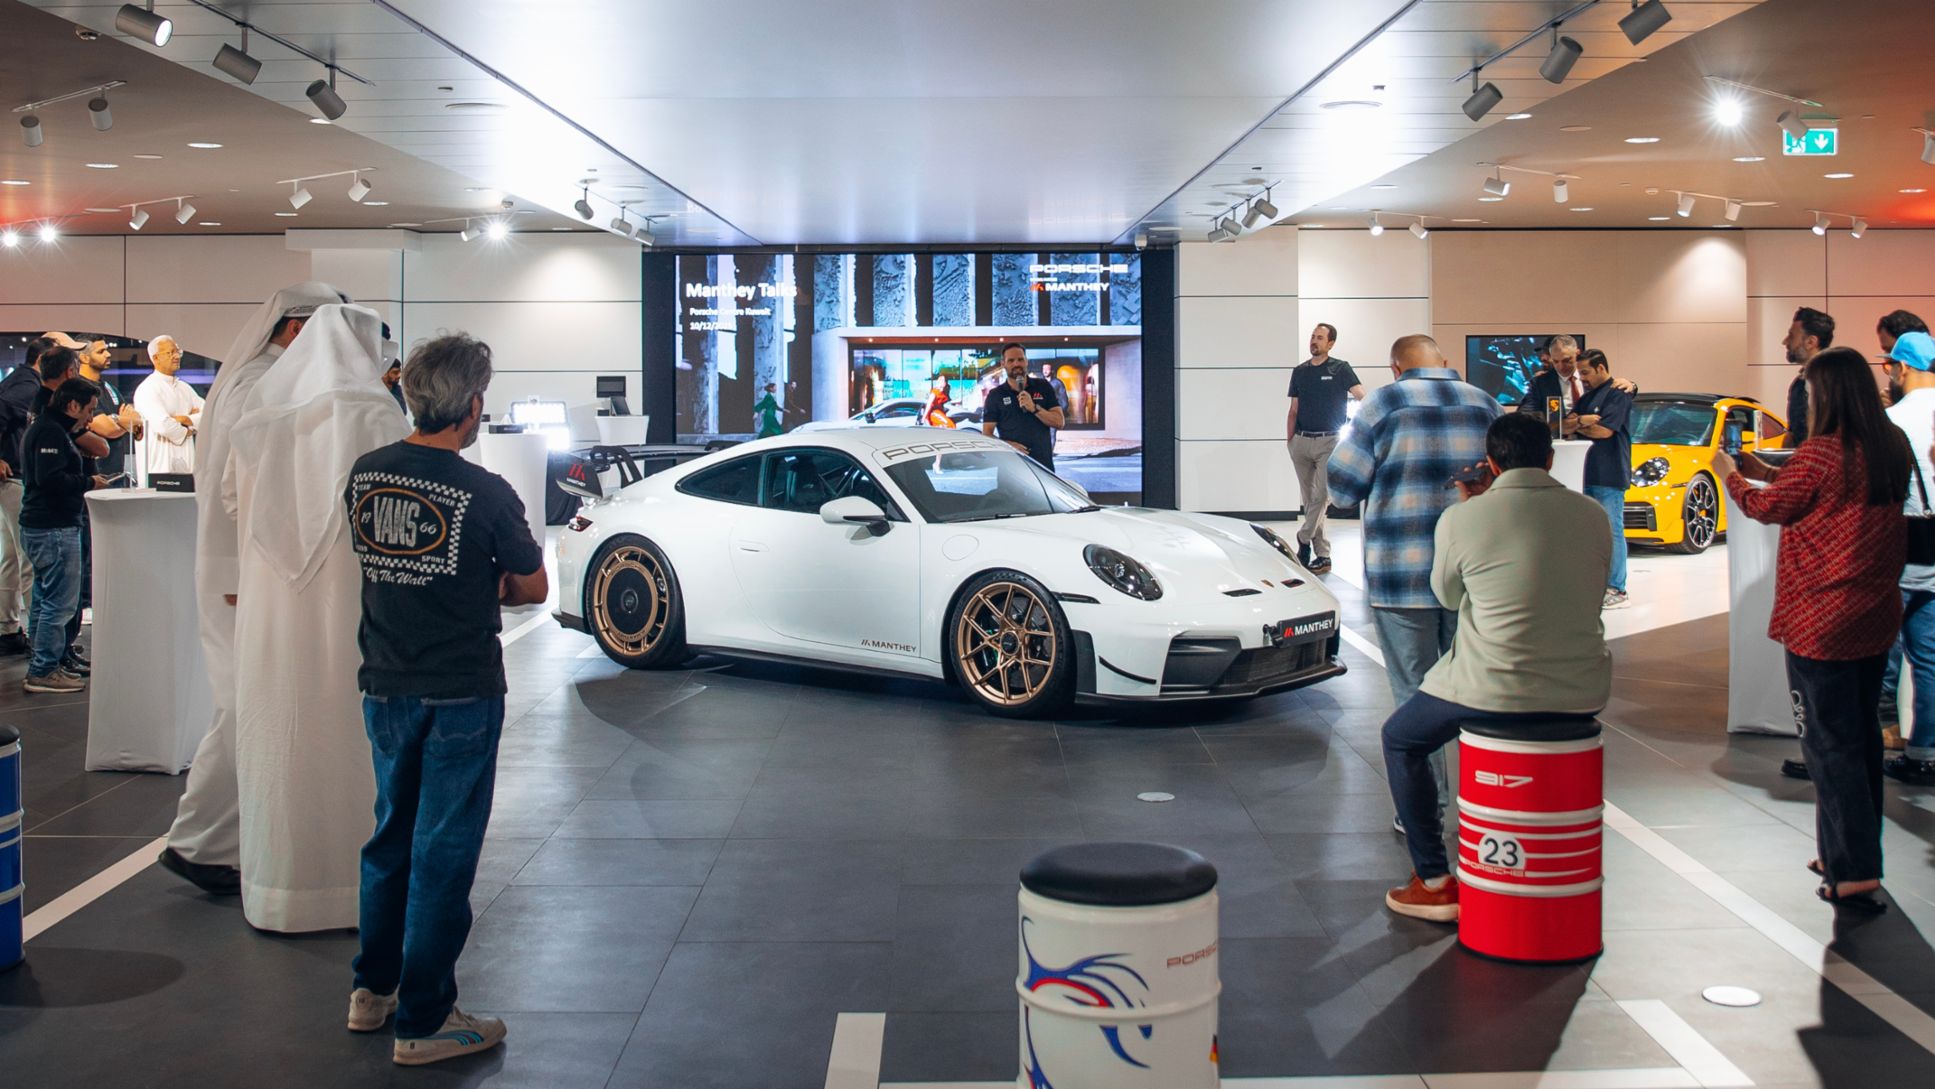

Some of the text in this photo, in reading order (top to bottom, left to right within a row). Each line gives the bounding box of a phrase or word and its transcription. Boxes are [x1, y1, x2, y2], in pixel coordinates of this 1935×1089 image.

[1029, 264, 1128, 273] PORSCHE
[686, 282, 798, 301] Manthey Talks
[1045, 282, 1110, 292] MANTHEY
[428, 493, 456, 507] PLAYER
[361, 496, 437, 547] 19 VANS 66
[421, 555, 446, 565] SPORT
[379, 569, 396, 583] The
[1294, 618, 1334, 636] MANTHEY
[871, 640, 917, 653] MANTHEY
[1475, 770, 1533, 788] 917
[1483, 837, 1519, 868] 23
[1464, 860, 1525, 877] PORSCHE
